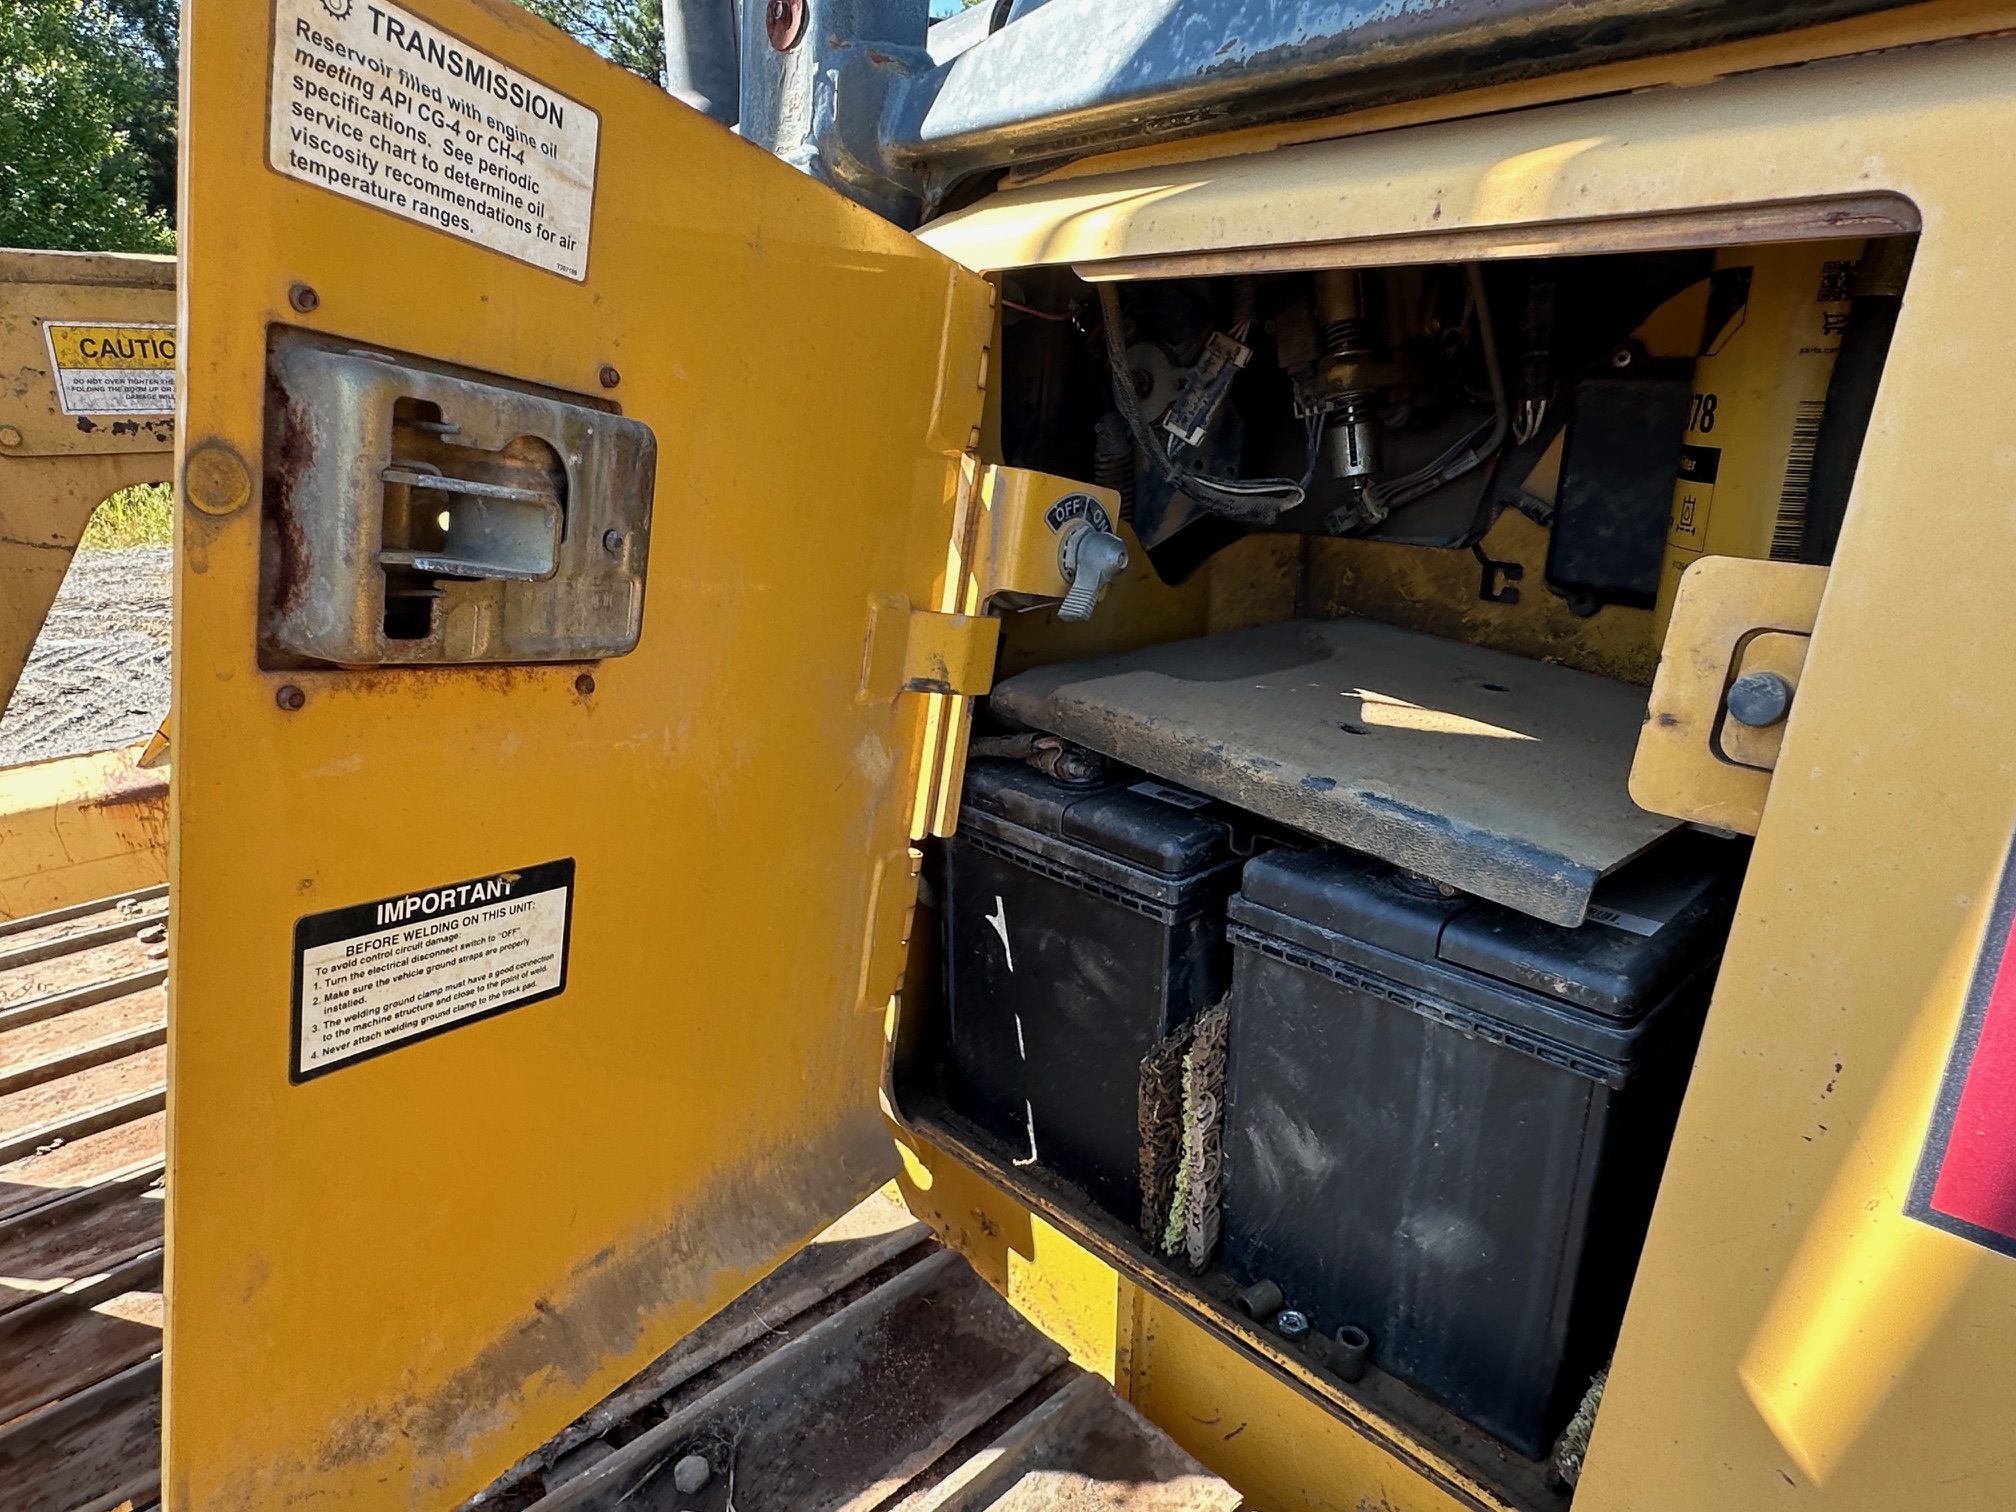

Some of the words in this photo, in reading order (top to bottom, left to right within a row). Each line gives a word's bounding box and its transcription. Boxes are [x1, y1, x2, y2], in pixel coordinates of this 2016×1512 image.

[296, 17, 393, 78] Reservoir
[399, 68, 442, 103] filled
[446, 95, 481, 122] with
[487, 115, 537, 149] engine
[541, 142, 557, 159] oil
[367, 4, 563, 129] TRANSMISSION
[292, 75, 431, 148] specifications.
[443, 138, 473, 165] See
[479, 158, 540, 194] periodic
[295, 48, 374, 101] meeting
[380, 86, 412, 114] API
[418, 103, 461, 136] CG-4
[466, 129, 483, 146] or
[488, 136, 525, 165] CH-4
[290, 126, 378, 175] viscosity
[385, 164, 532, 234] recommendations
[536, 223, 556, 243] for
[559, 235, 577, 251] air
[290, 149, 406, 207] temperature
[412, 199, 474, 233] ranges.
[292, 101, 363, 142] service
[370, 134, 417, 165] chart
[422, 153, 438, 173] to
[444, 165, 523, 209] determine
[527, 201, 545, 218] oil
[80, 338, 176, 359] CAUTIO
[1055, 498, 1081, 521] OFF
[1093, 509, 1108, 532] ON
[313, 982, 322, 990] 1.
[325, 975, 347, 987] Turn
[350, 970, 365, 980] the
[367, 957, 409, 976] electrical
[411, 946, 458, 964] disconnect
[460, 936, 486, 950] switch
[488, 934, 496, 943] to
[315, 967, 328, 976] To
[331, 958, 357, 972] avoid
[360, 950, 393, 965] control
[395, 943, 423, 955] circuit
[425, 932, 461, 947] damage:
[345, 934, 400, 957] BEFORE
[403, 919, 459, 942] WELDING
[462, 913, 479, 927] ON
[482, 907, 507, 922] THIS
[510, 900, 536, 915] UNIT:
[311, 1024, 320, 1033] 3.
[323, 1018, 341, 1029] The
[344, 1006, 380, 1023] welding
[383, 995, 415, 1012] ground
[417, 987, 443, 1001] clamp
[445, 980, 466, 991] must
[467, 974, 486, 985] have
[495, 964, 515, 978] good
[515, 953, 555, 970] connection
[312, 997, 321, 1006] 2.
[324, 989, 349, 1002] Make
[352, 982, 373, 994] sure
[375, 977, 390, 988] the
[393, 968, 424, 982] vehicle
[426, 959, 456, 975] ground
[458, 951, 483, 964] straps
[485, 947, 498, 956] are
[499, 938, 530, 954] properly
[322, 1033, 333, 1042] to
[335, 1026, 350, 1037] the
[353, 1014, 392, 1032] machine
[394, 1001, 434, 1019] structure
[436, 995, 451, 1006] and
[453, 988, 475, 1000] close
[476, 984, 485, 992] to
[486, 980, 499, 990] the
[500, 974, 520, 987] point
[521, 970, 529, 979] of
[323, 996, 367, 1015] installed.
[310, 1051, 319, 1060] 4.
[322, 1041, 351, 1056] Never
[353, 1031, 381, 1046] attach
[384, 1019, 419, 1036] welding
[420, 1008, 451, 1025] ground
[452, 1000, 477, 1014] clamp
[478, 997, 487, 1005] to
[488, 993, 500, 1002] the
[502, 986, 520, 997] track
